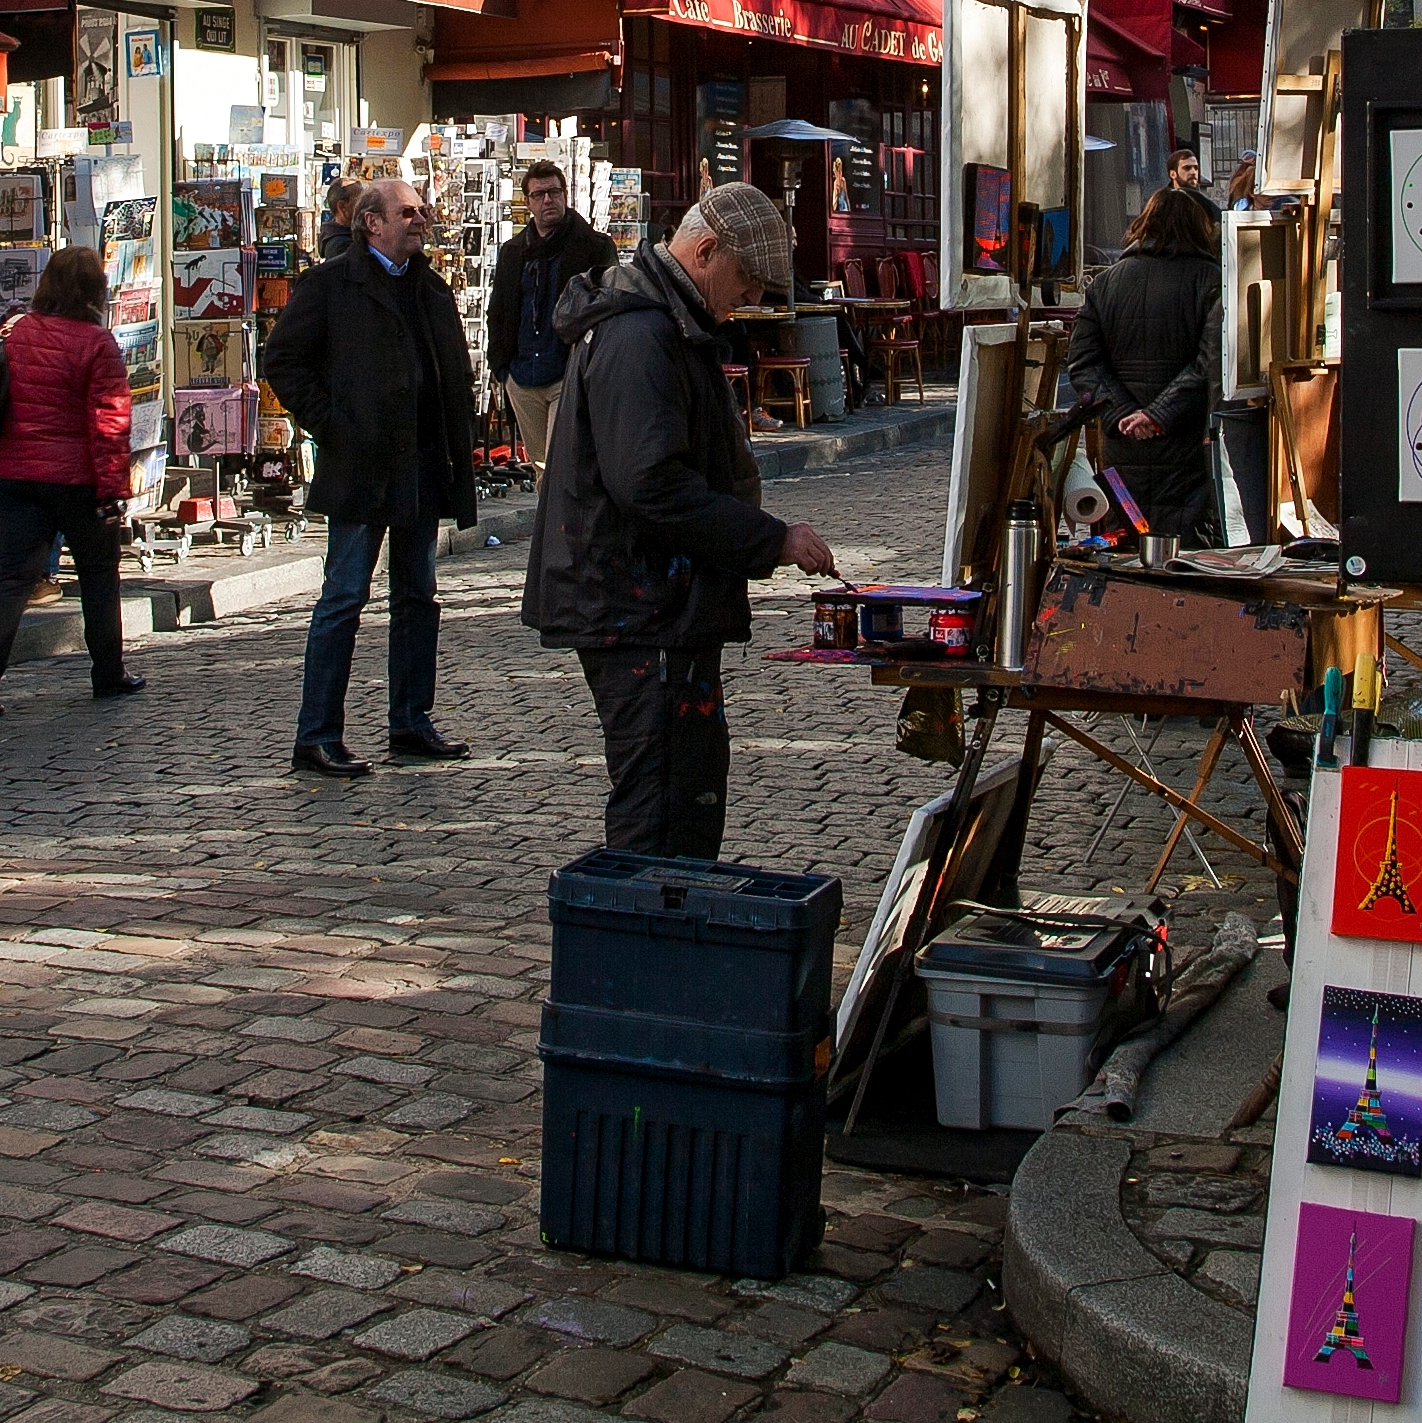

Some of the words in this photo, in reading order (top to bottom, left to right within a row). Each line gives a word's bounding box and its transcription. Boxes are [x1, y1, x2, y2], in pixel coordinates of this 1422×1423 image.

[202, 15, 211, 27] AU
[212, 16, 230, 29] SINGE
[732, 0, 791, 38] Brasserie
[841, 23, 859, 49] AU
[860, 19, 906, 58] CADET
[911, 37, 926, 60] de
[206, 31, 217, 42] QUI
[218, 32, 227, 43] LIT
[41, 130, 85, 140] Cartexpo
[353, 128, 401, 138] Cartexpo
